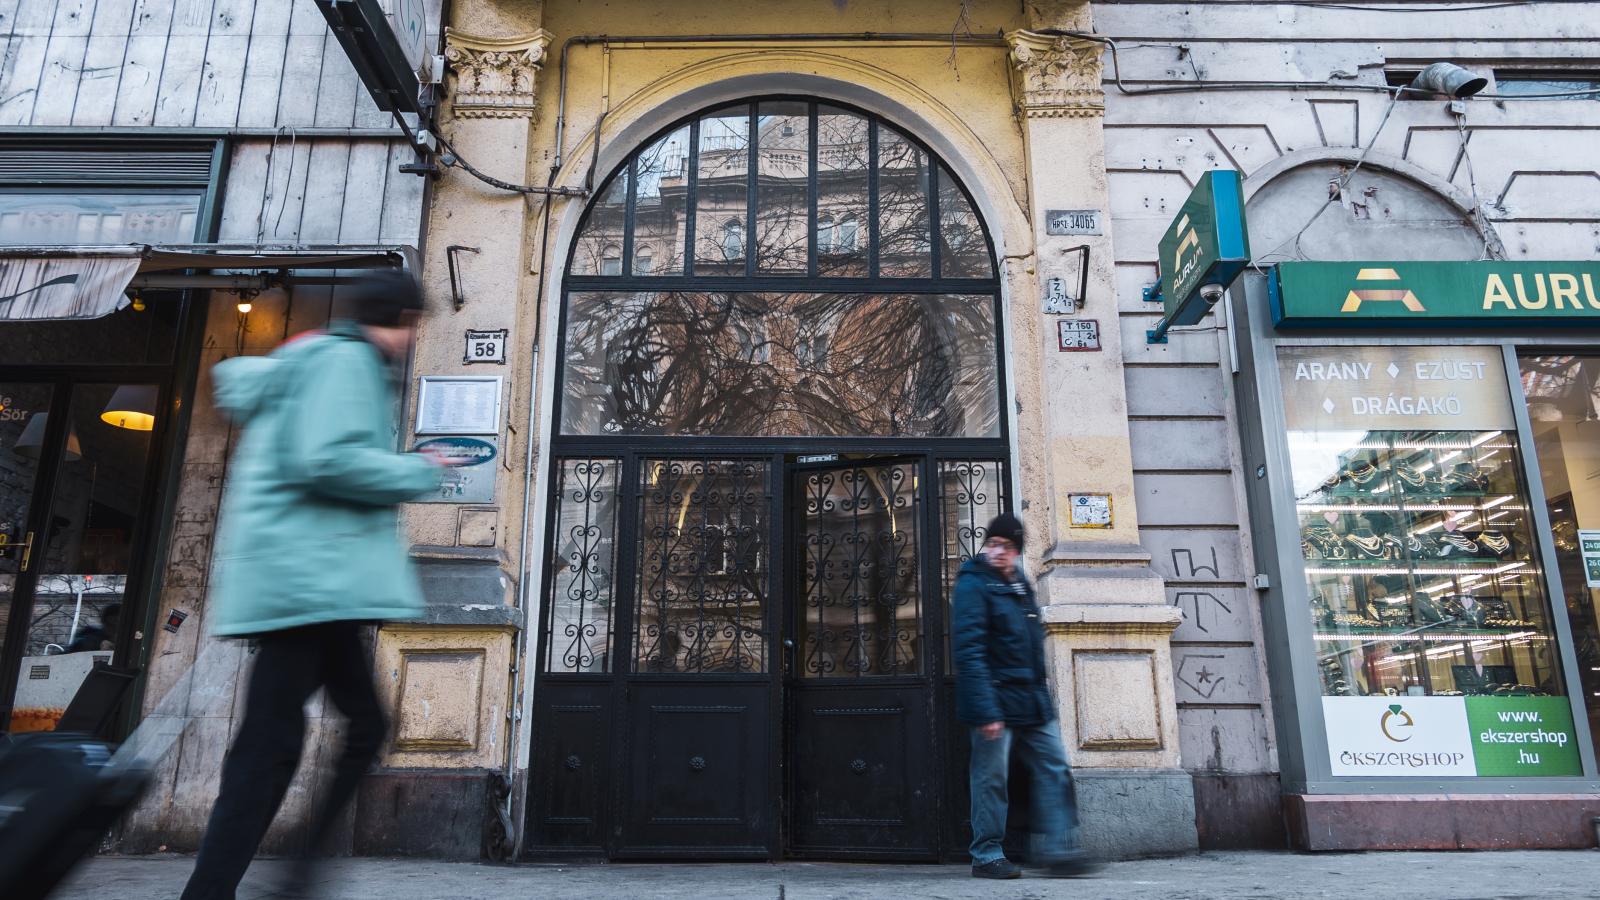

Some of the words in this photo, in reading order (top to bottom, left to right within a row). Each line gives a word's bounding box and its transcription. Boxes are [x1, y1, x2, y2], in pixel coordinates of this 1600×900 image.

[1172, 246, 1203, 294] AURUM
[1076, 322, 1091, 330] 150
[475, 342, 495, 357] 58
[1295, 362, 1372, 381] ARANY
[0, 408, 28, 421] Sör
[1497, 710, 1543, 723] www.
[1480, 729, 1567, 747] ekszershop
[1517, 749, 1540, 764] .hu
